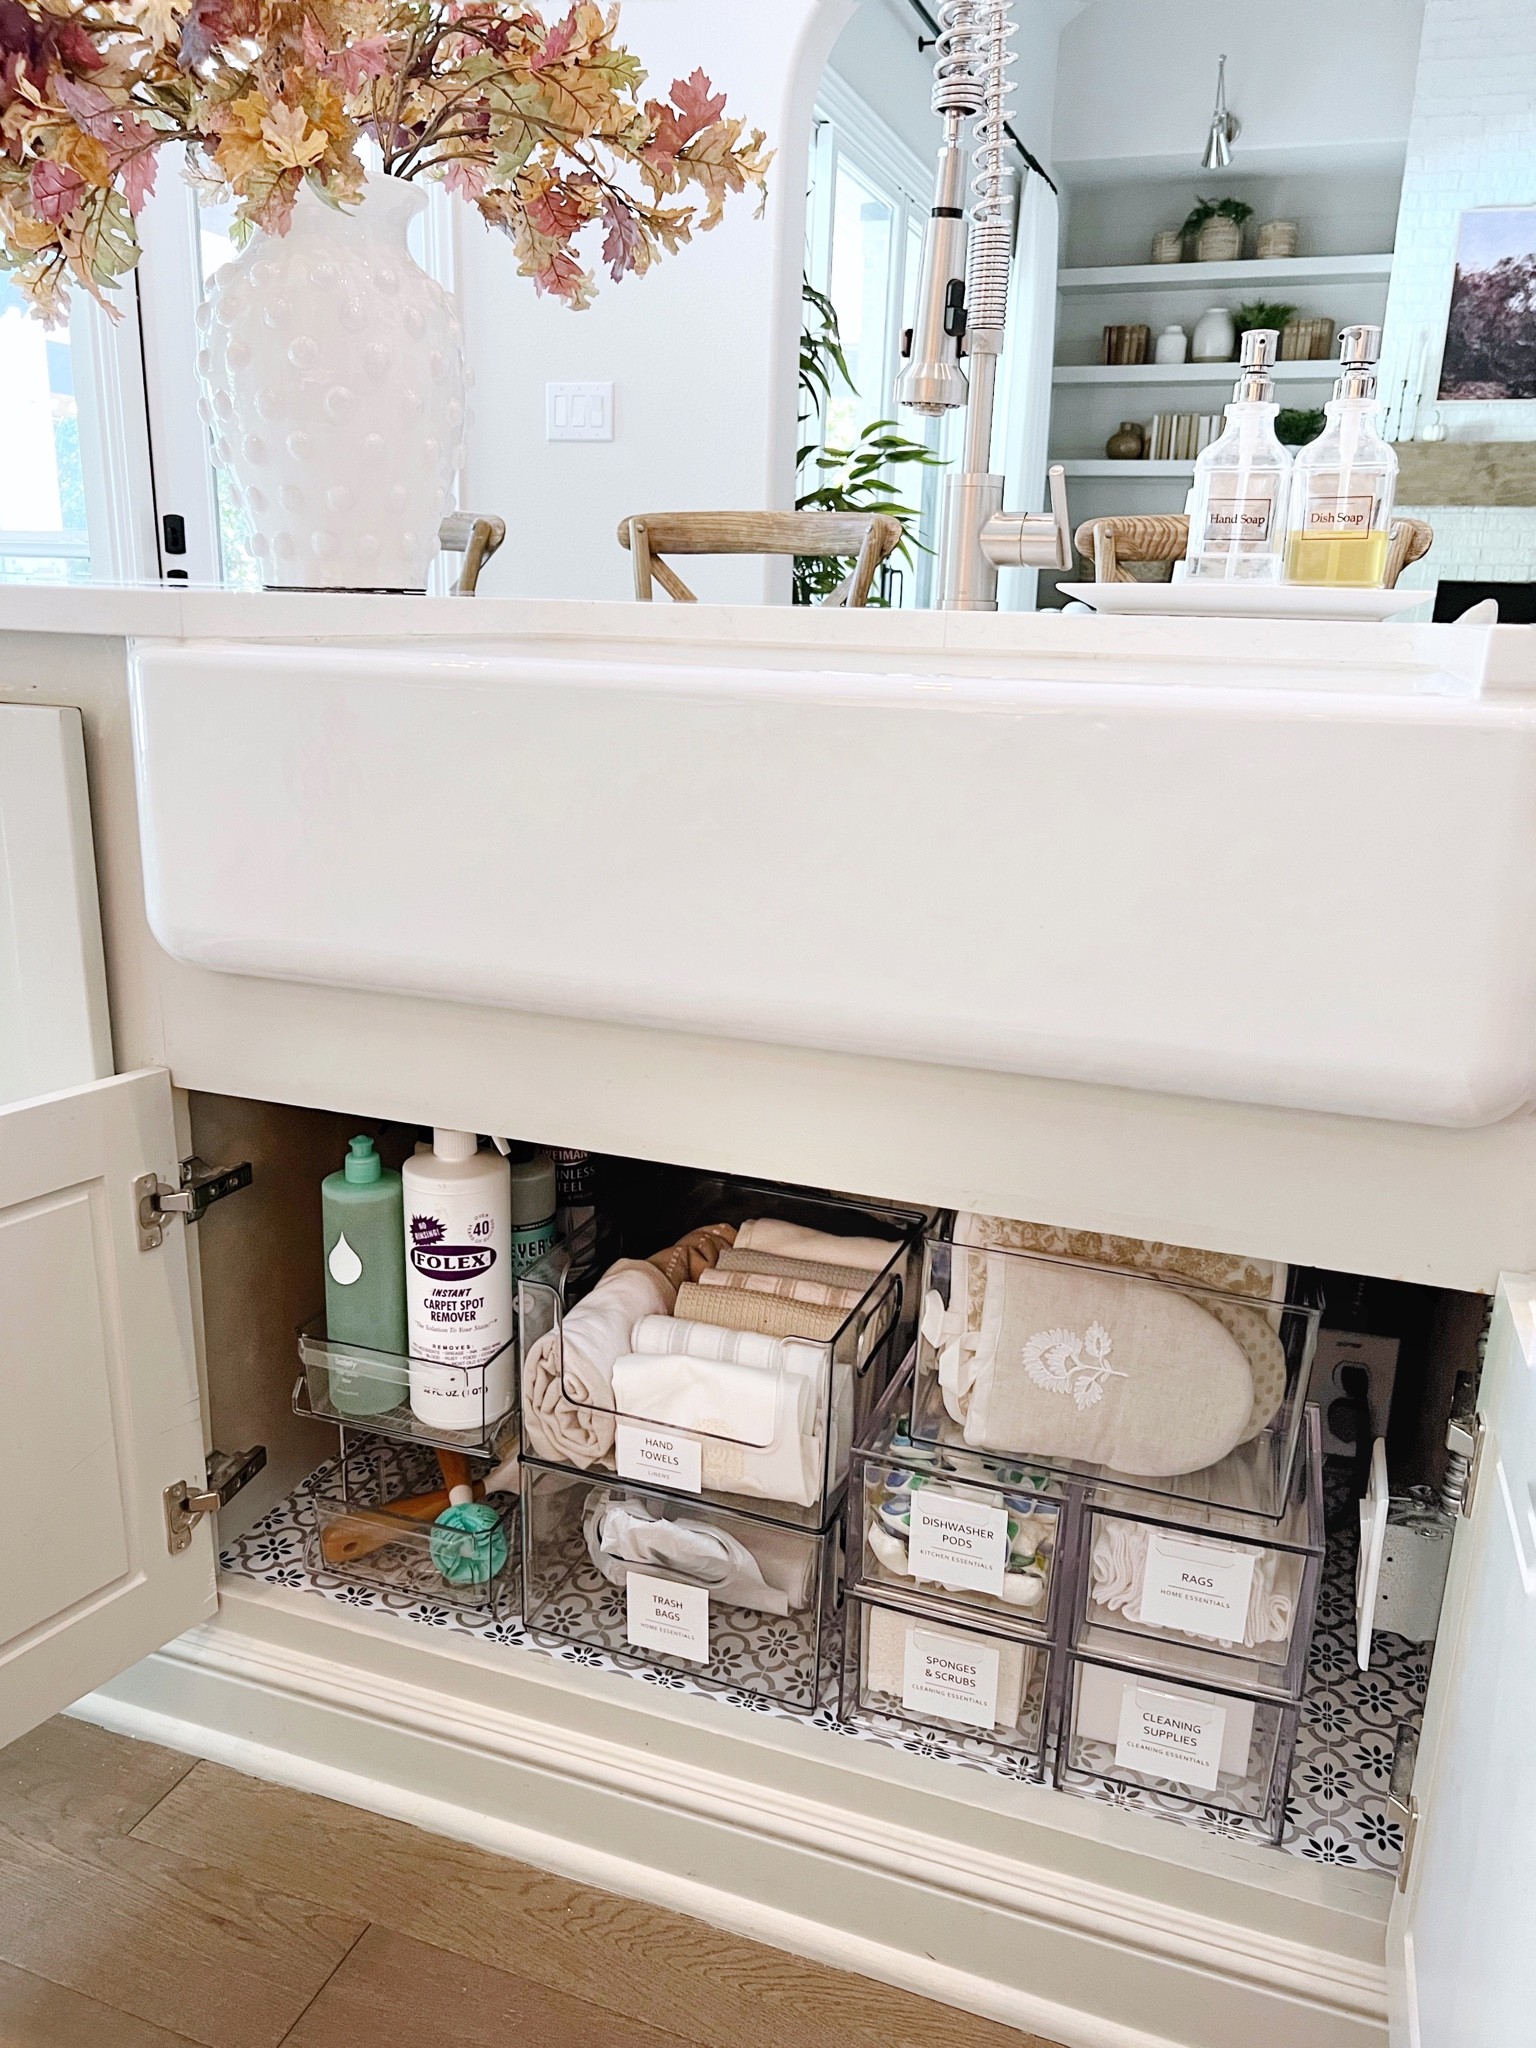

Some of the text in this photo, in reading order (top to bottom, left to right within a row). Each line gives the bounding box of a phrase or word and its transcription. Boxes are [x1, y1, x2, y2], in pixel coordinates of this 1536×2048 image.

[1210, 513, 1266, 527] Hand Soap
[1310, 512, 1364, 524] Dish Soap
[473, 1220, 490, 1236] 40
[416, 1253, 486, 1269] FOLEX
[431, 1287, 472, 1298] INSTANT
[423, 1297, 485, 1311] CARPET SPOT
[430, 1310, 476, 1323] REMOVER
[645, 1437, 674, 1451] HAND
[640, 1449, 679, 1466] TOWELS
[648, 1470, 670, 1480] LINENS
[922, 1516, 994, 1540] DISHWASHER
[942, 1535, 973, 1549] PODS
[920, 1549, 993, 1570] KITCHEN ESSENTIALS
[1181, 1573, 1214, 1588] RAGS
[652, 1595, 684, 1610] TRASH
[1160, 1588, 1231, 1609] HOME ESSENTIALS
[655, 1608, 681, 1622] BAGS
[640, 1622, 695, 1640] HOME ESSENTIALS
[926, 1655, 977, 1675] SPONGES
[925, 1668, 976, 1688] & SCRUBS
[911, 1683, 988, 1706] CLEANING ESSENTIALS
[1142, 1712, 1201, 1734] CLEANING
[1143, 1725, 1197, 1747] SUPPLIES
[1126, 1740, 1210, 1767] CLEANING ESSENTIALS
